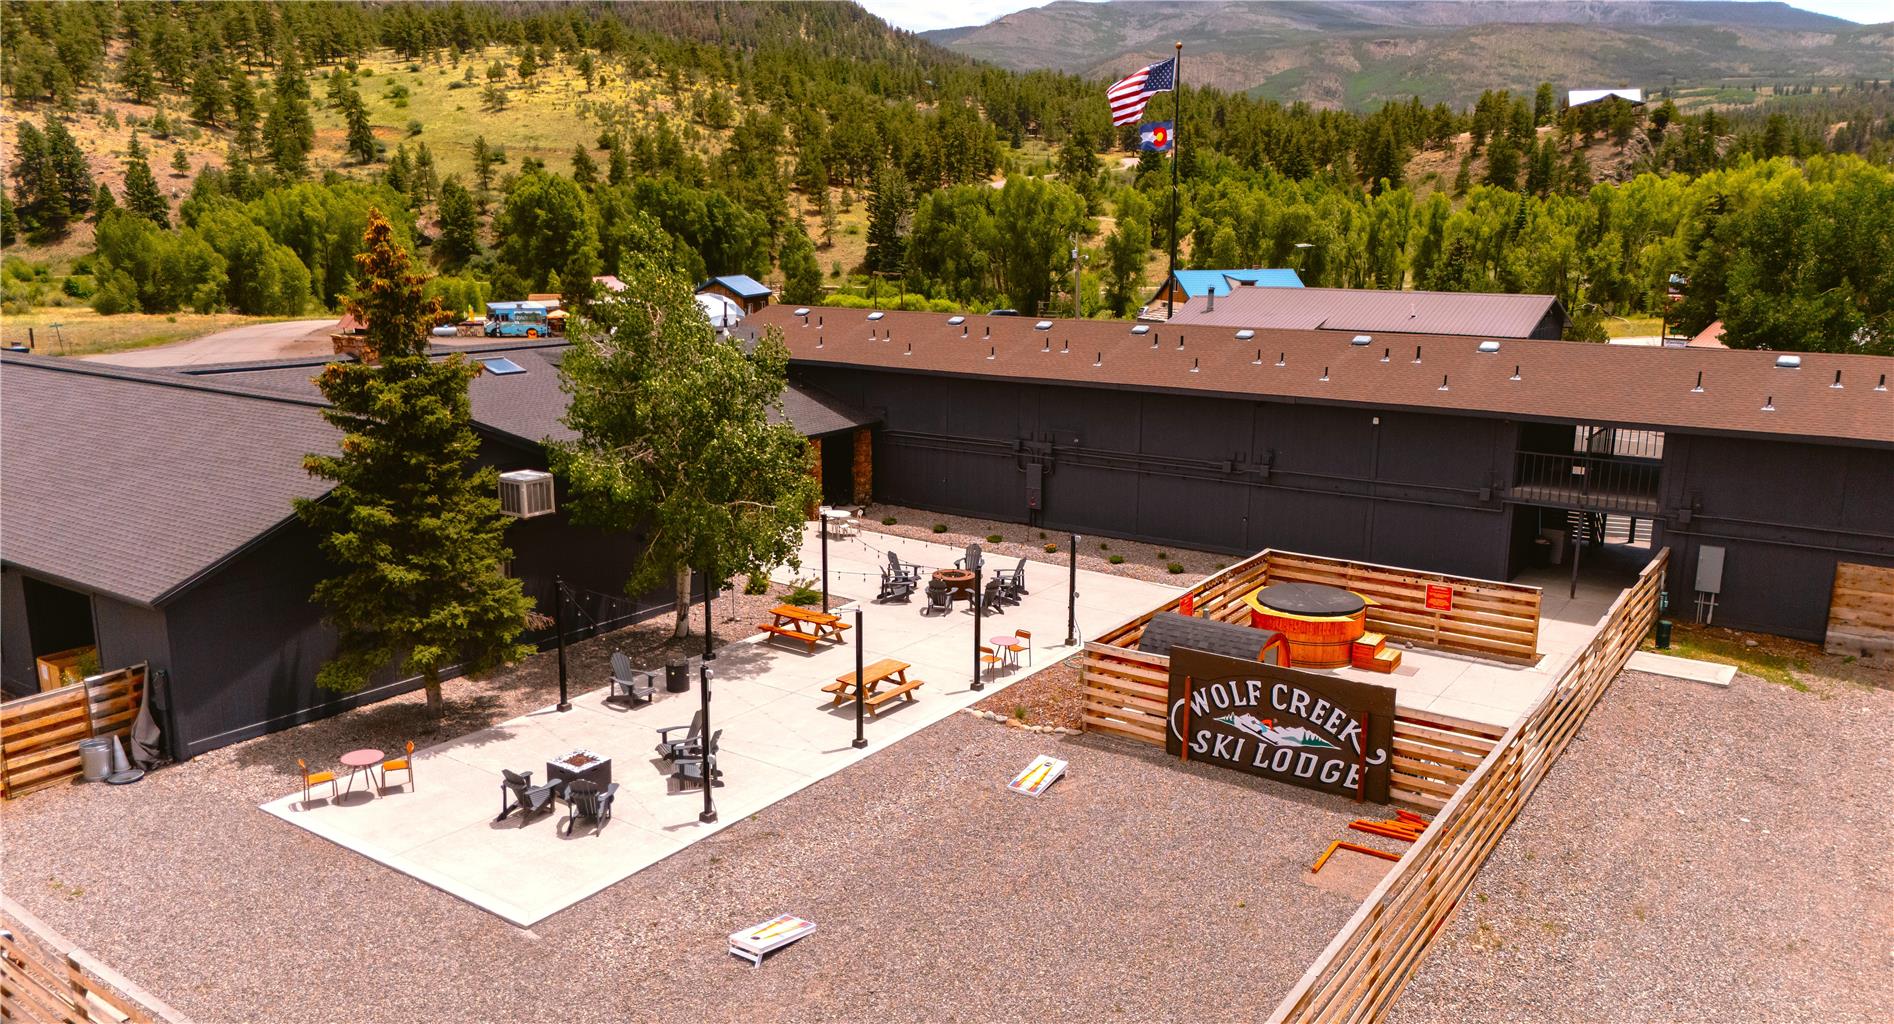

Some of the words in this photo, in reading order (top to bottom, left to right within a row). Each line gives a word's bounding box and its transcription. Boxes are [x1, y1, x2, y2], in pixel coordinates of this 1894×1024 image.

[1190, 680, 1262, 717] WOLF
[1272, 683, 1371, 757] CREEK
[1188, 730, 1246, 762] SKI
[1252, 742, 1368, 790] LODGE
